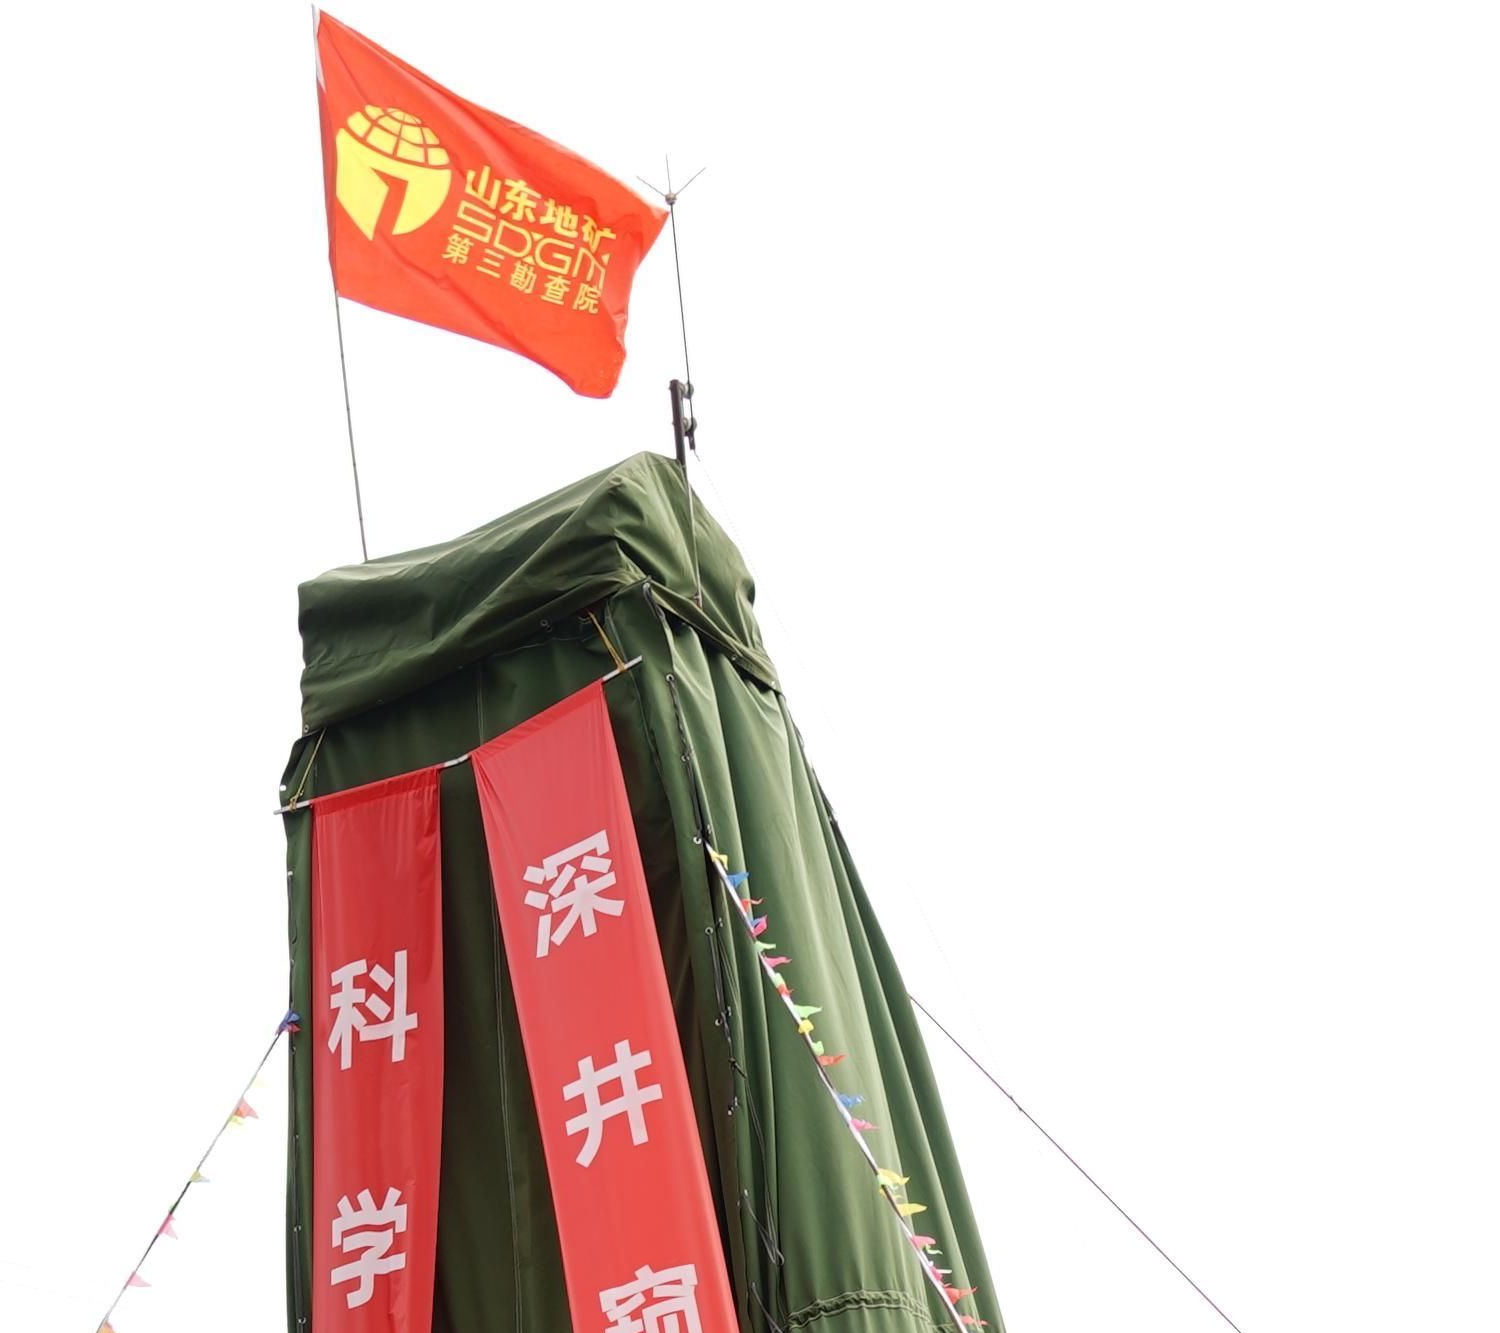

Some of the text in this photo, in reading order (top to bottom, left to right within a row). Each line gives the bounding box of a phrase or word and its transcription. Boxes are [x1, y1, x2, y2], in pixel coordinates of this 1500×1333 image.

[464, 165, 616, 256] 山东地矿
[442, 234, 602, 314] 第三勘查院
